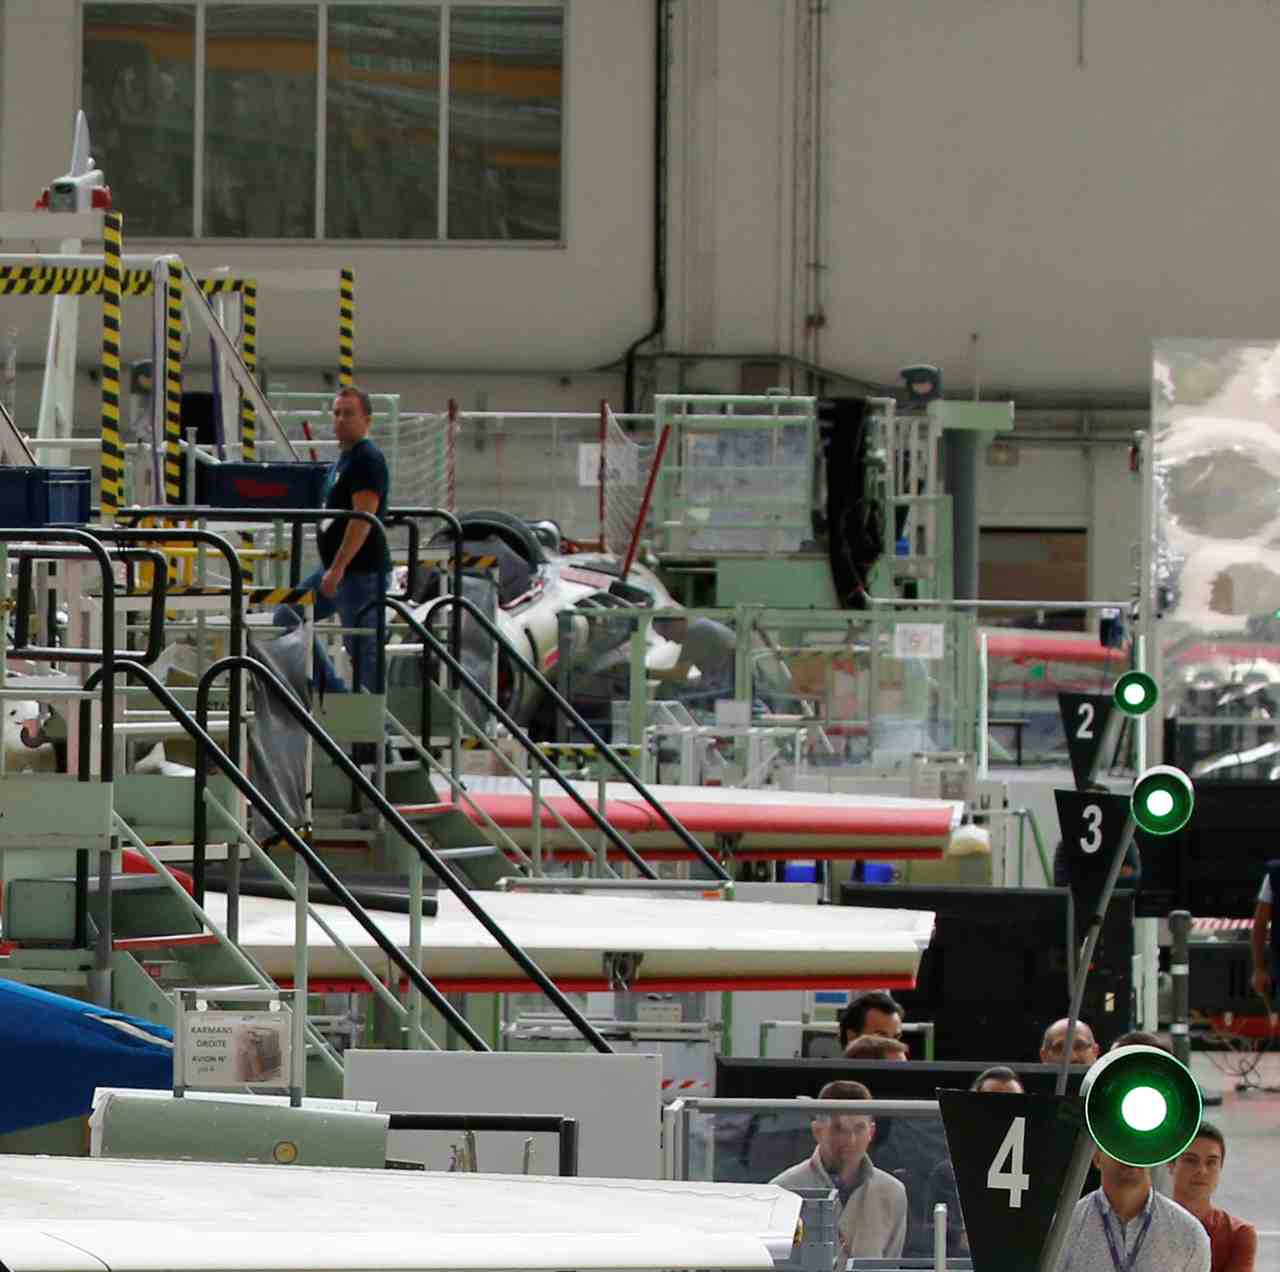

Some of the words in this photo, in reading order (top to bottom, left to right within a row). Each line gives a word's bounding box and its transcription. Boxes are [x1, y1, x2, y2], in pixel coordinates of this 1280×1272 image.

[1076, 702, 1095, 739] 2
[1080, 804, 1103, 854] 3
[987, 1116, 1030, 1208] 4
